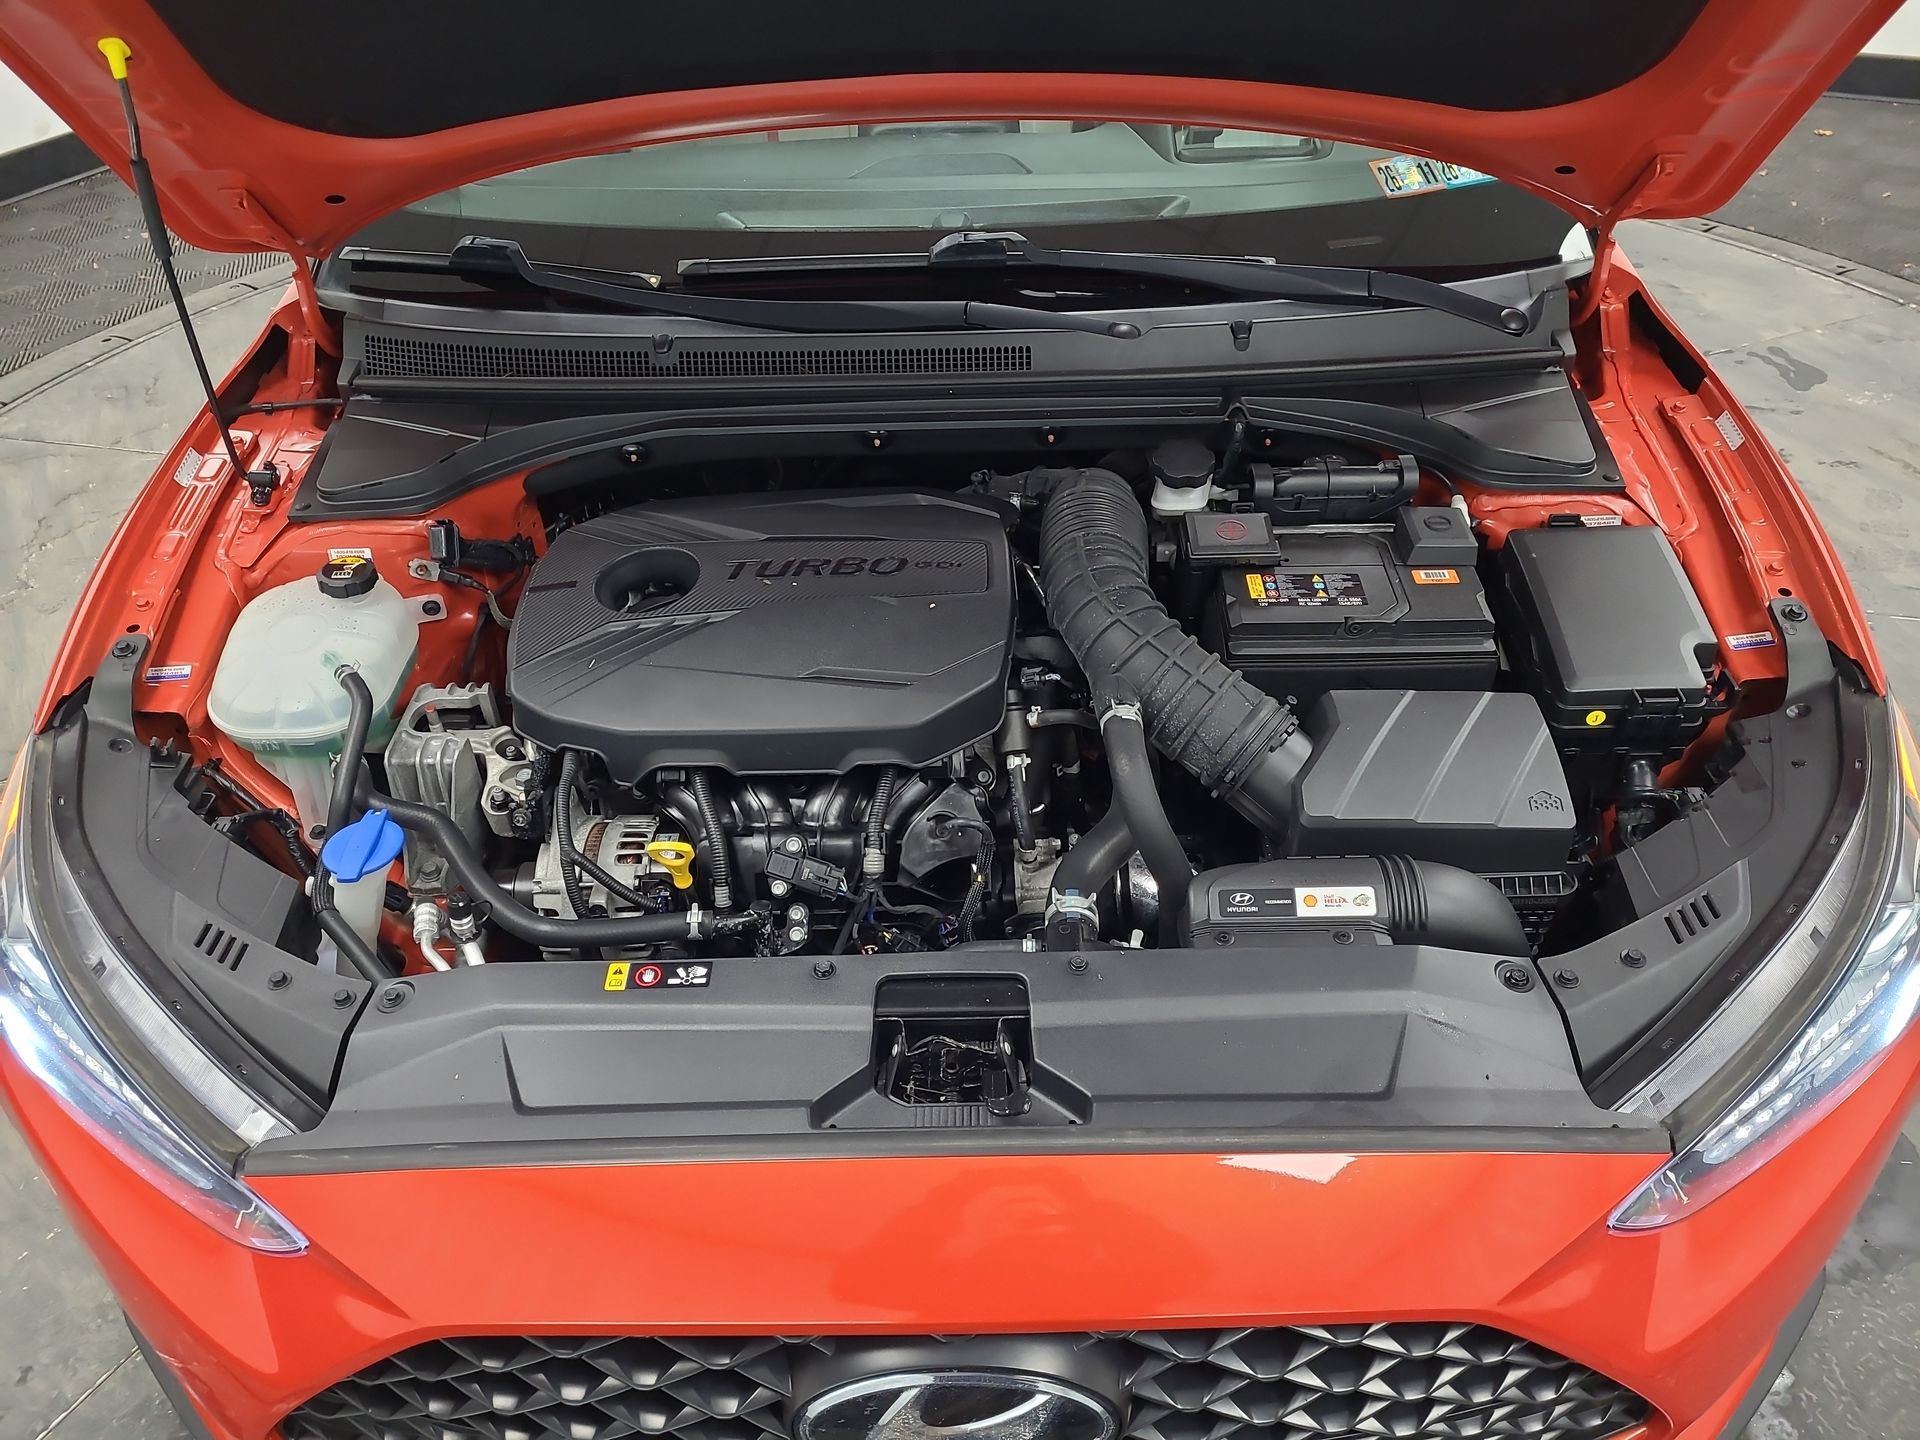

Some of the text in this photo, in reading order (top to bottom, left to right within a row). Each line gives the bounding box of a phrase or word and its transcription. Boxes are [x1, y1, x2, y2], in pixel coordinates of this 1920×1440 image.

[1377, 162, 1438, 192] 26 11
[727, 557, 909, 581] TURBO
[1324, 896, 1349, 904] HELIX
